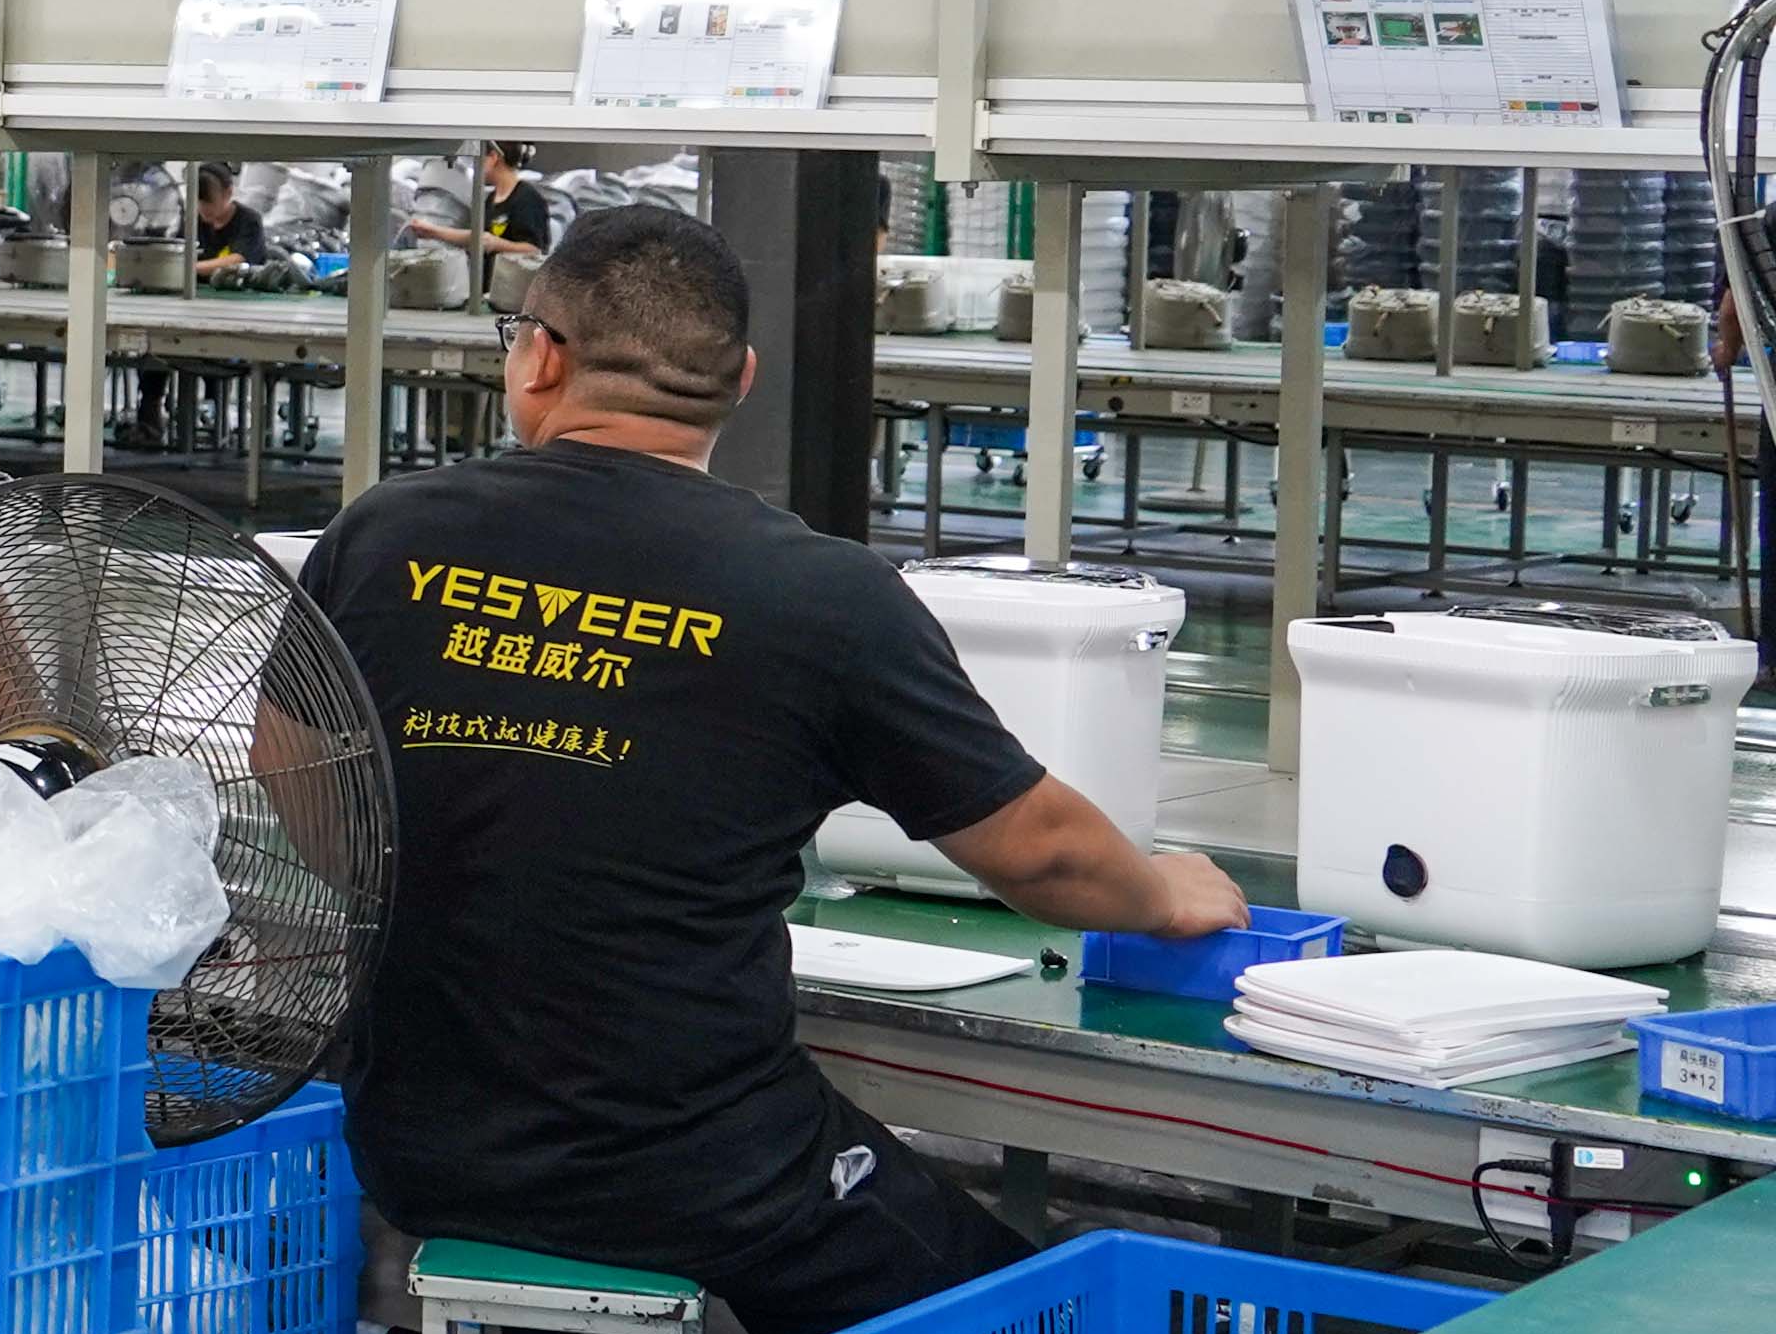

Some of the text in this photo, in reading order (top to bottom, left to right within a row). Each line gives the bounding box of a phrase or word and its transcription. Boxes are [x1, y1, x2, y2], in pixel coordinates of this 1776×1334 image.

[407, 560, 723, 657] YESVEER
[442, 622, 633, 690] 越盛威尔
